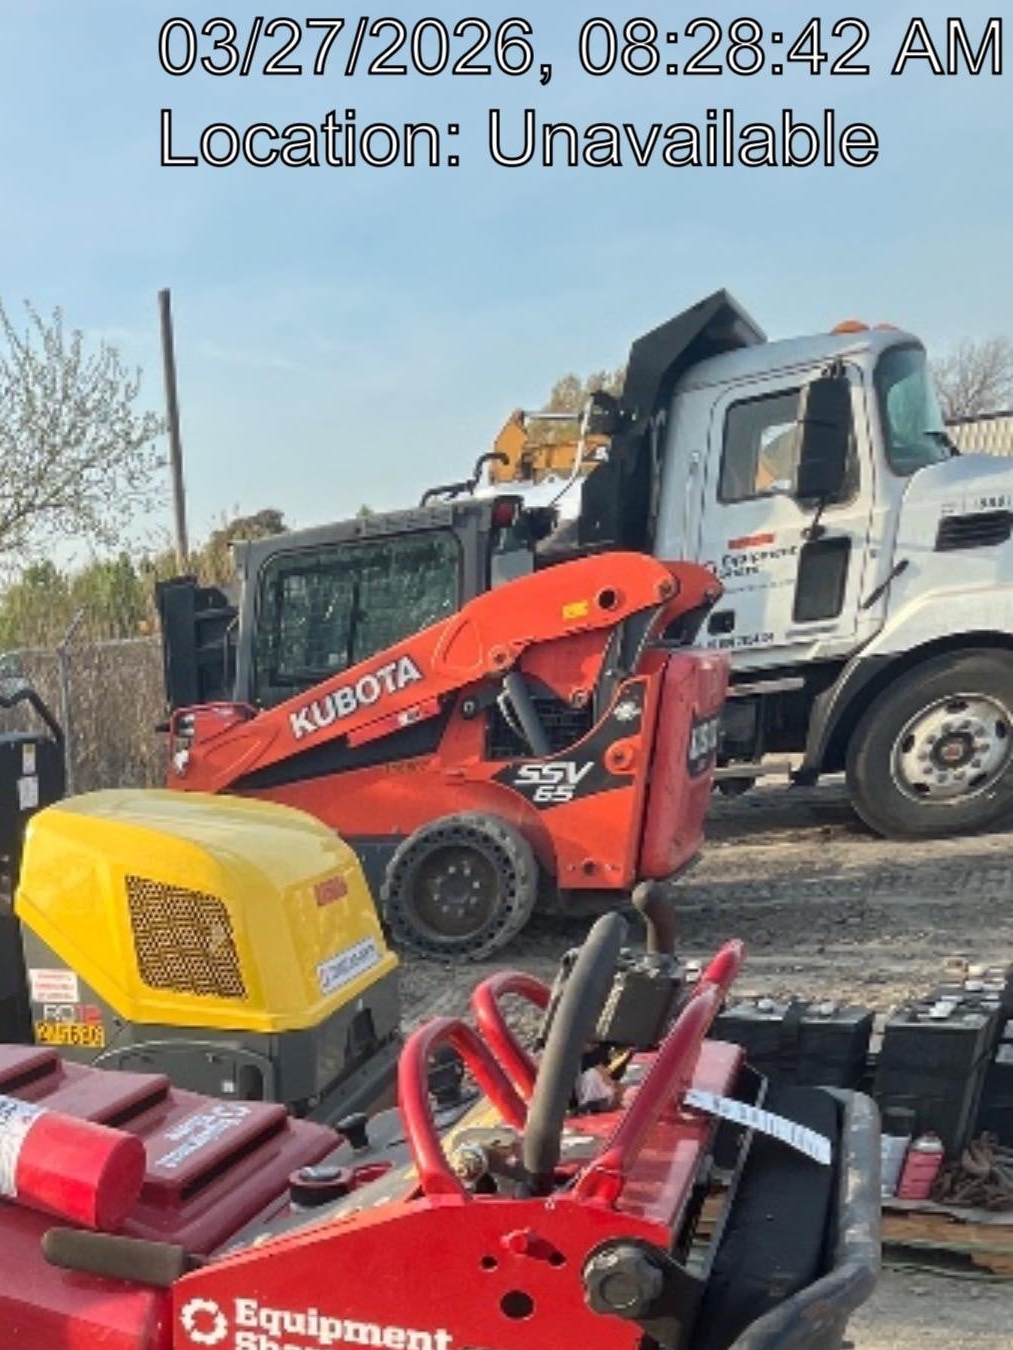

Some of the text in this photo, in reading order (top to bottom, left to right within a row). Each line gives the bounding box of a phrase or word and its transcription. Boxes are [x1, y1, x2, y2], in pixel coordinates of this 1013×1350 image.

[287, 655, 423, 739] KUBOTA
[514, 761, 595, 785] SSV
[532, 784, 576, 803] 65
